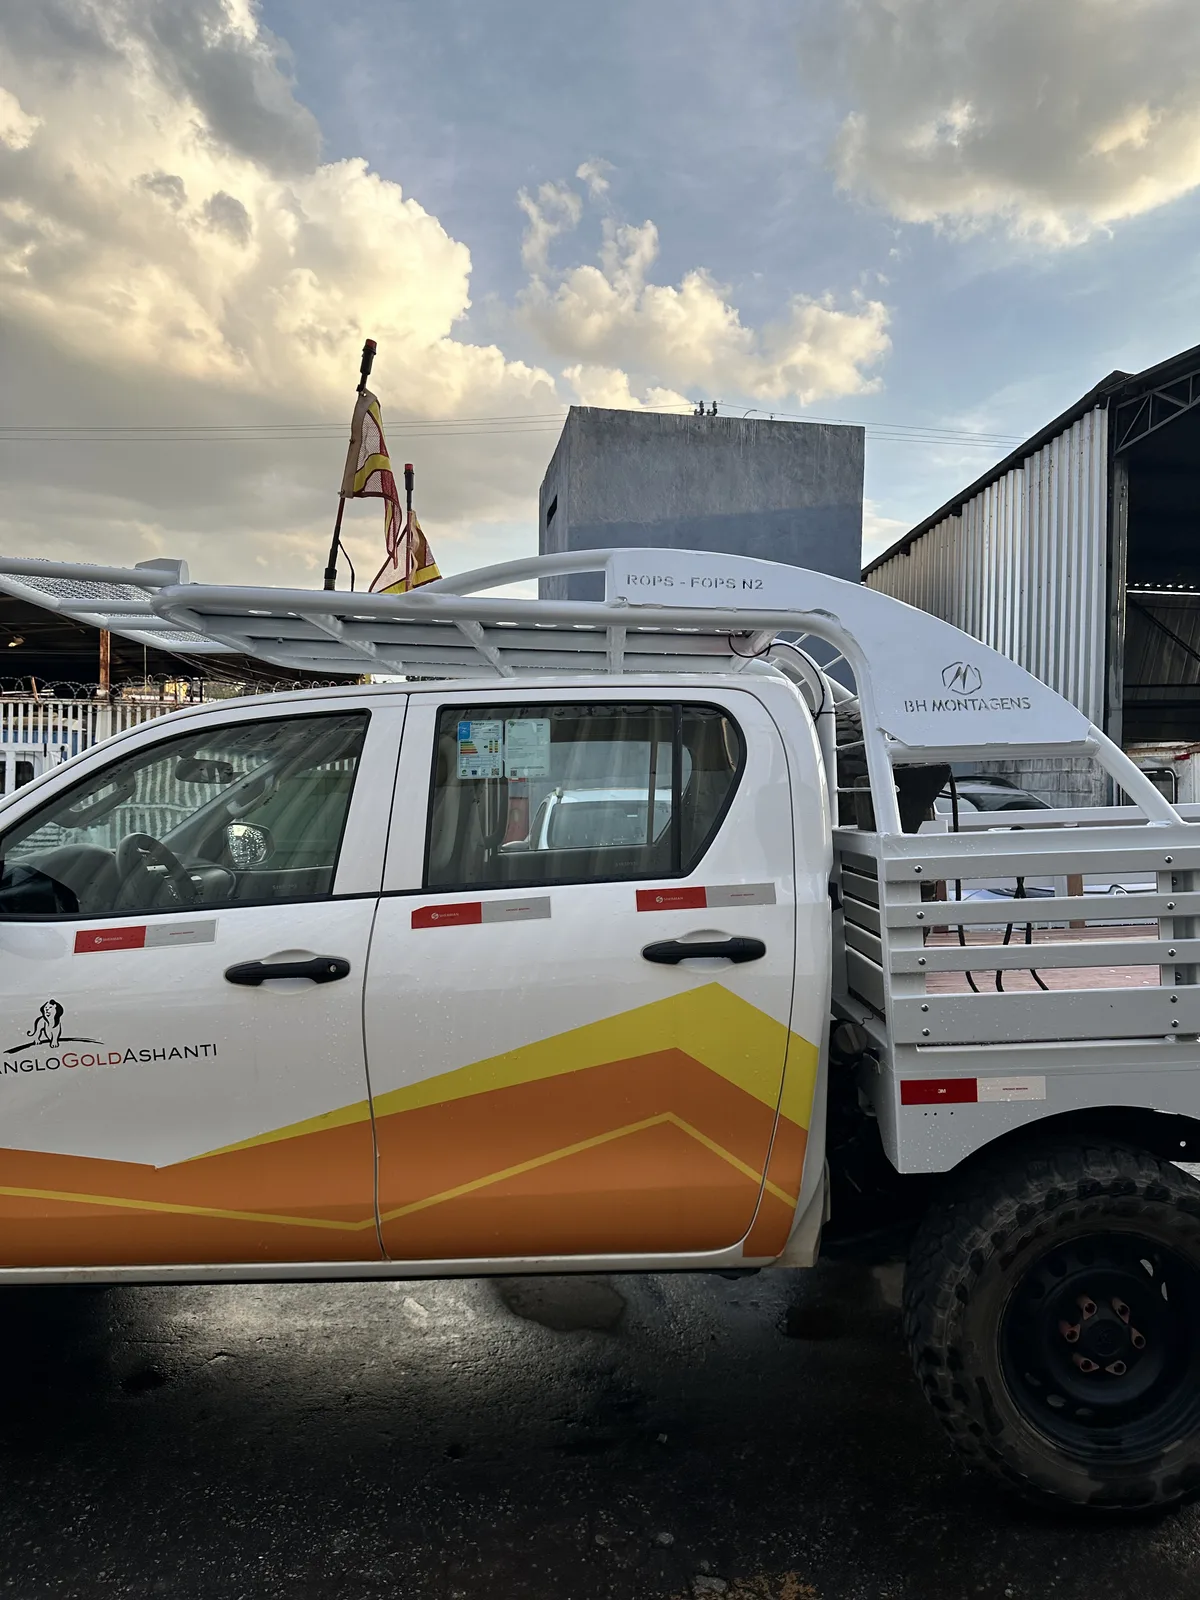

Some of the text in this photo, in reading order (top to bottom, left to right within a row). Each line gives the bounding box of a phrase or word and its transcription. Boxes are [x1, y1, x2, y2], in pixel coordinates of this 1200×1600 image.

[627, 574, 674, 587] ROPS
[691, 577, 736, 589] FOPS
[742, 579, 763, 590] N2
[904, 697, 1031, 713] BH MONTAGENS
[0, 1043, 218, 1075] NGLOGOLDASHANTI
